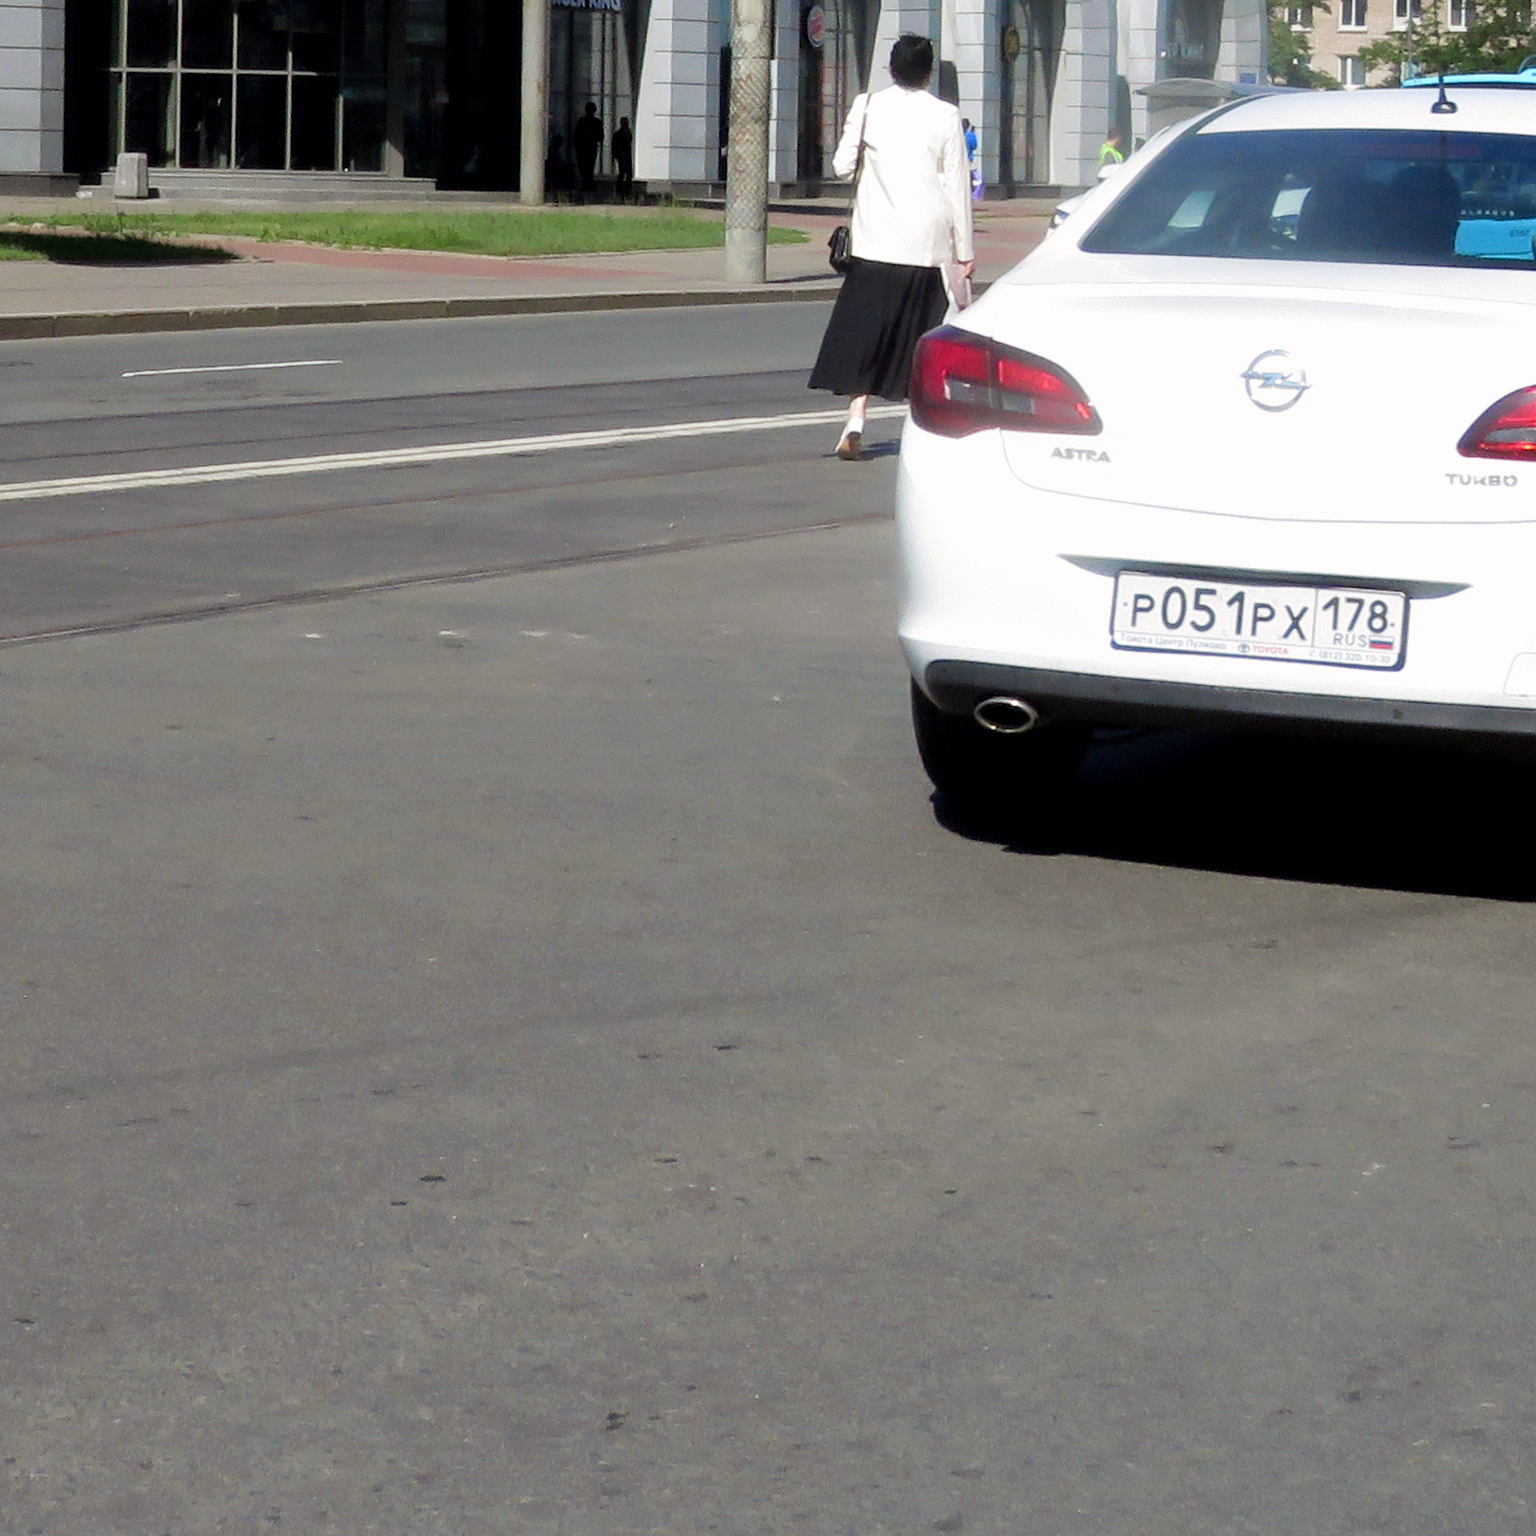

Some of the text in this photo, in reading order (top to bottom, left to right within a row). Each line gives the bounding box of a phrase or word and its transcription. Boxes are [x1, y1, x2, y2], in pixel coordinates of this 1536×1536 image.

[1050, 447, 1112, 463] ASTRA
[1444, 473, 1518, 487] TURBO
[1321, 595, 1389, 633] 178
[1332, 632, 1368, 648] RUS
[1252, 644, 1290, 655] TOYOTA
